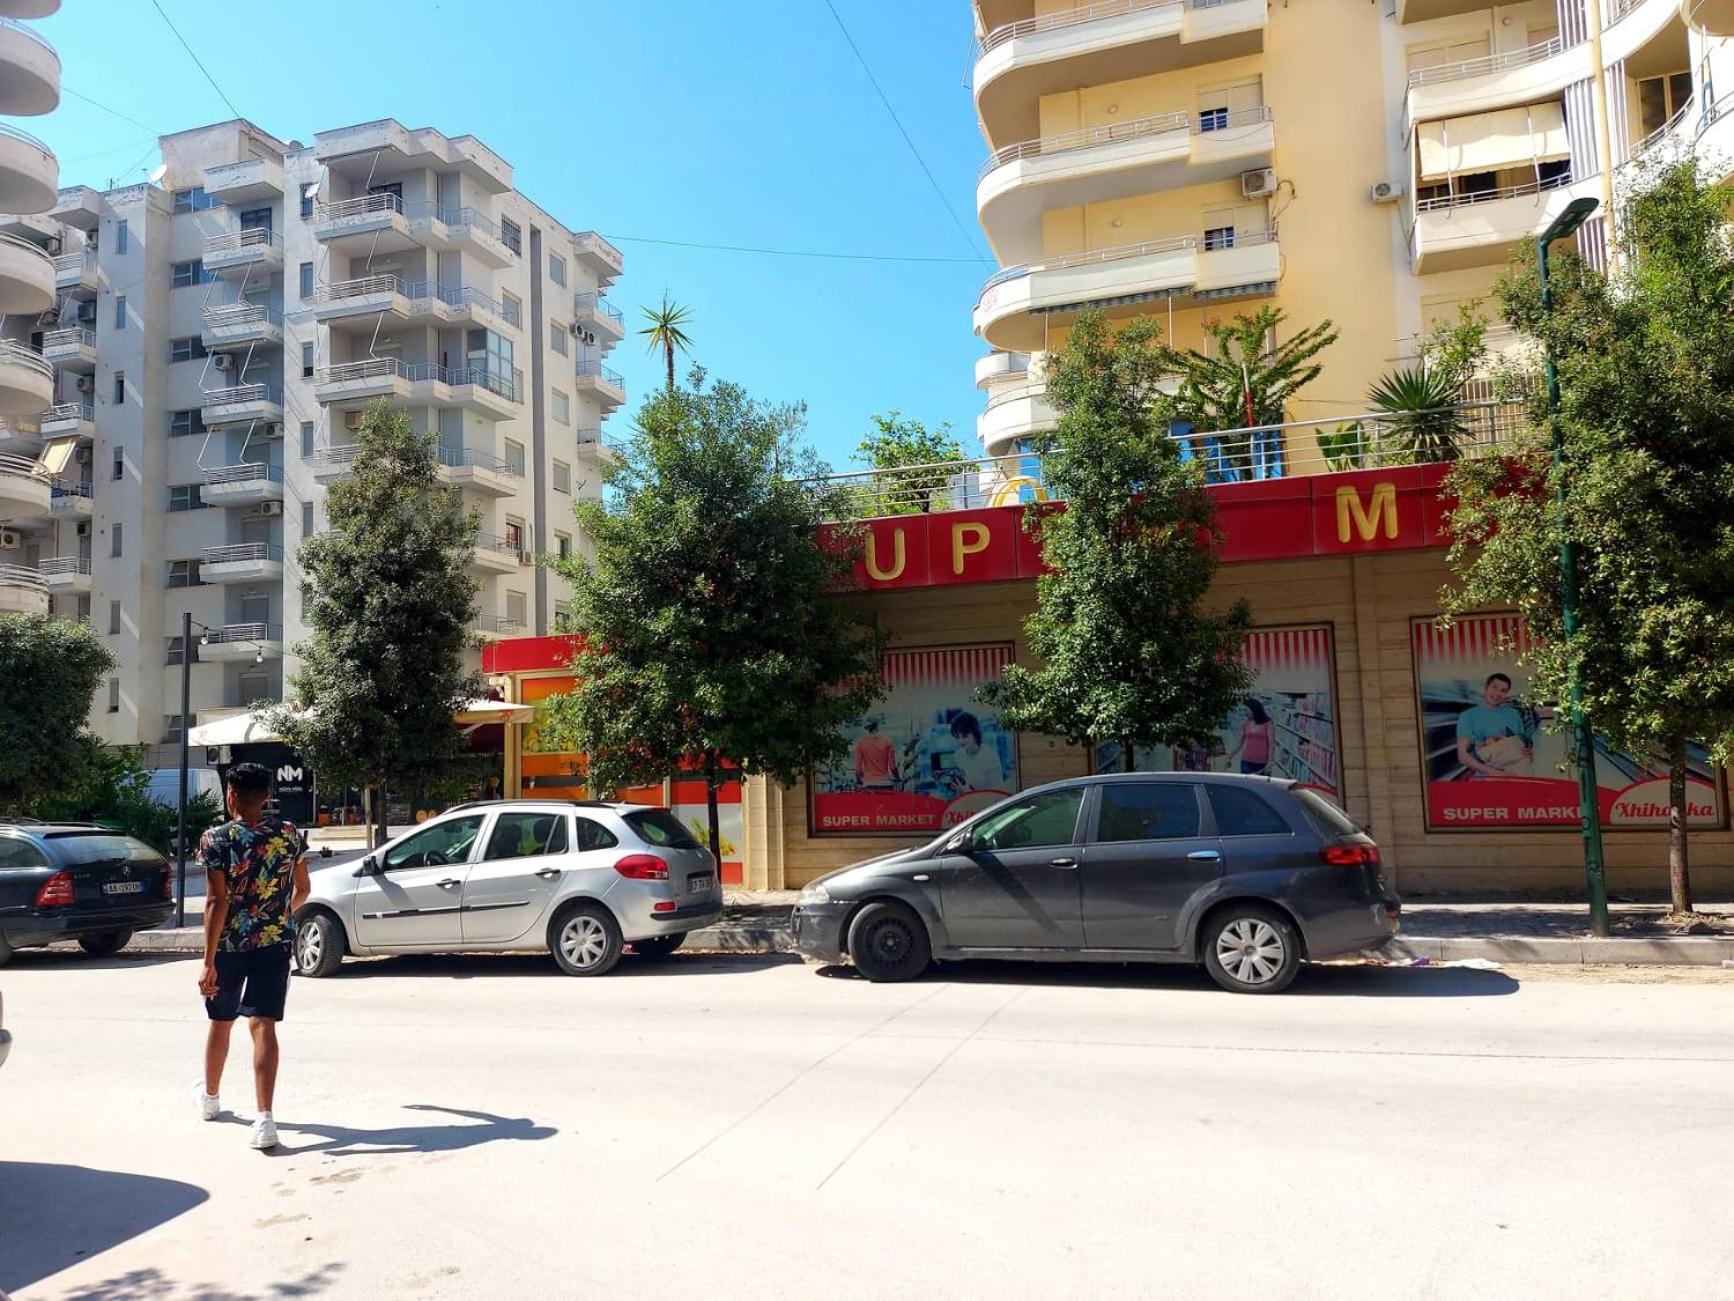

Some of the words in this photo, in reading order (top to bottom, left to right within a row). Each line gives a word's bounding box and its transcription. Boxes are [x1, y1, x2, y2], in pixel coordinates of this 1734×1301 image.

[277, 764, 303, 782] NM
[822, 814, 870, 827] SUPER
[876, 813, 935, 826] MARKET
[1442, 806, 1509, 821] SUPER
[1517, 806, 1601, 820] MARK
